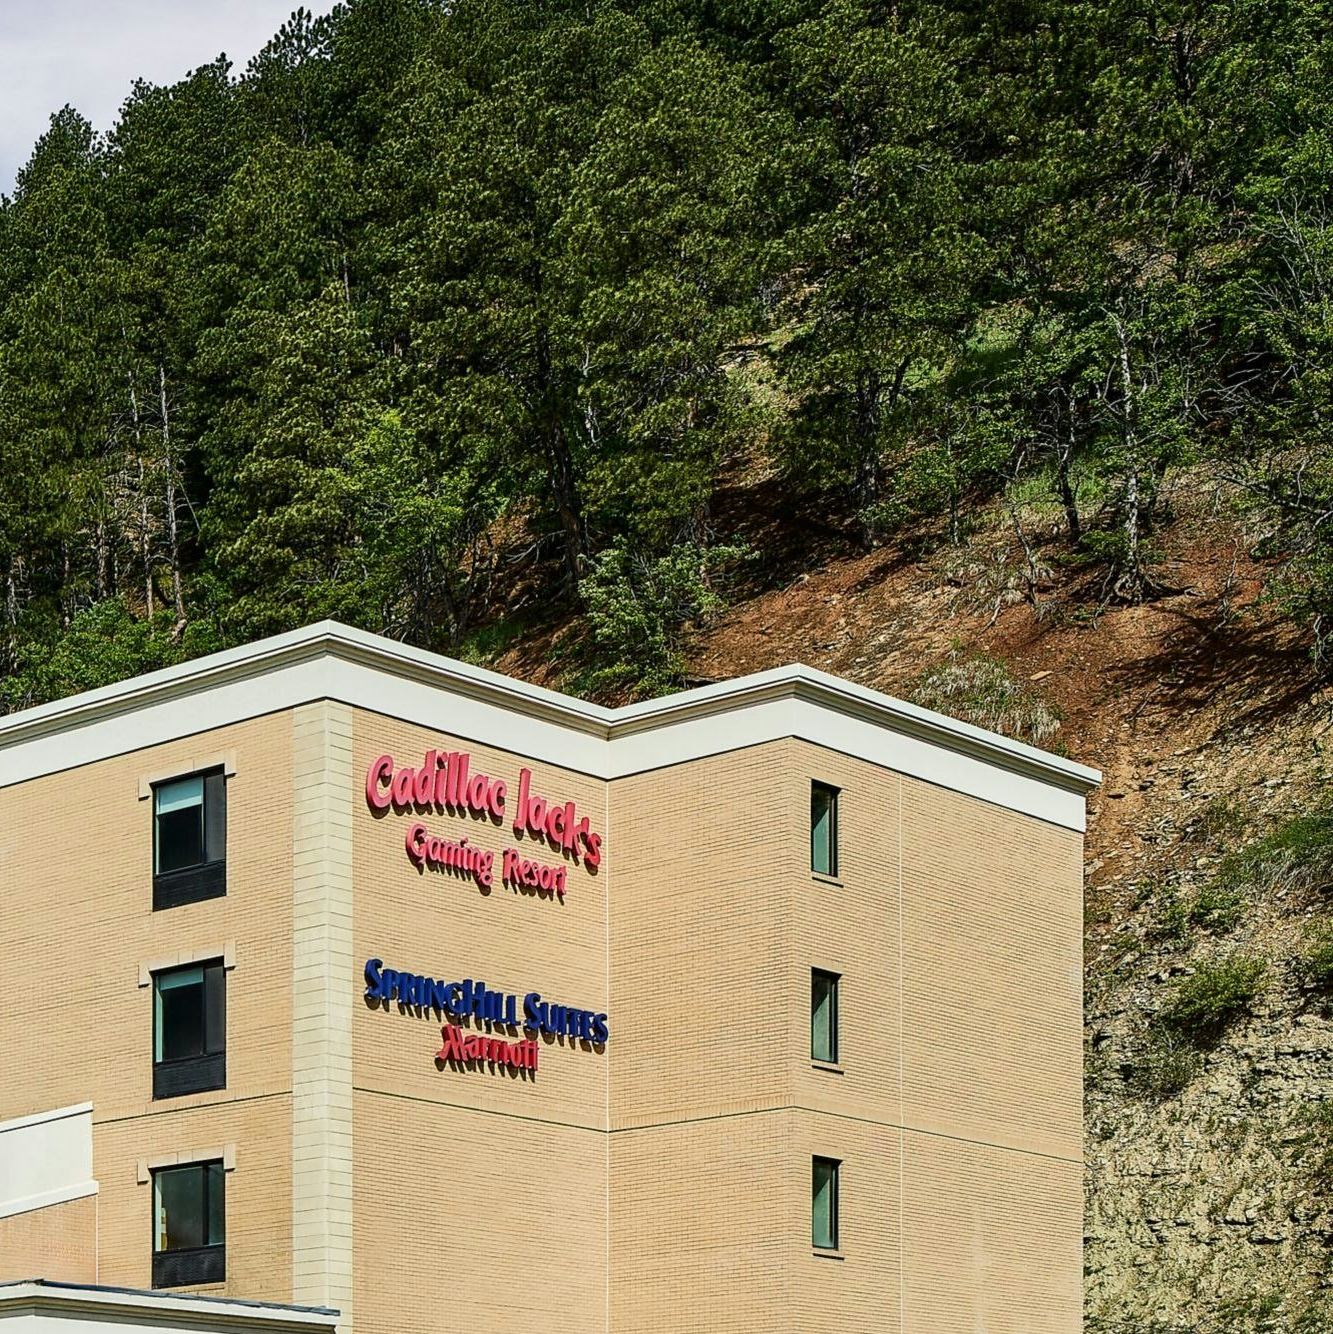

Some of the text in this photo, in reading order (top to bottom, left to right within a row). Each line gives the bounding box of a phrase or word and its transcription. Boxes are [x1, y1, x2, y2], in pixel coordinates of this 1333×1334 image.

[366, 749, 603, 867] Cadillac Jack's
[406, 823, 567, 895] Gaming Resort
[435, 1023, 539, 1071] Marriott
